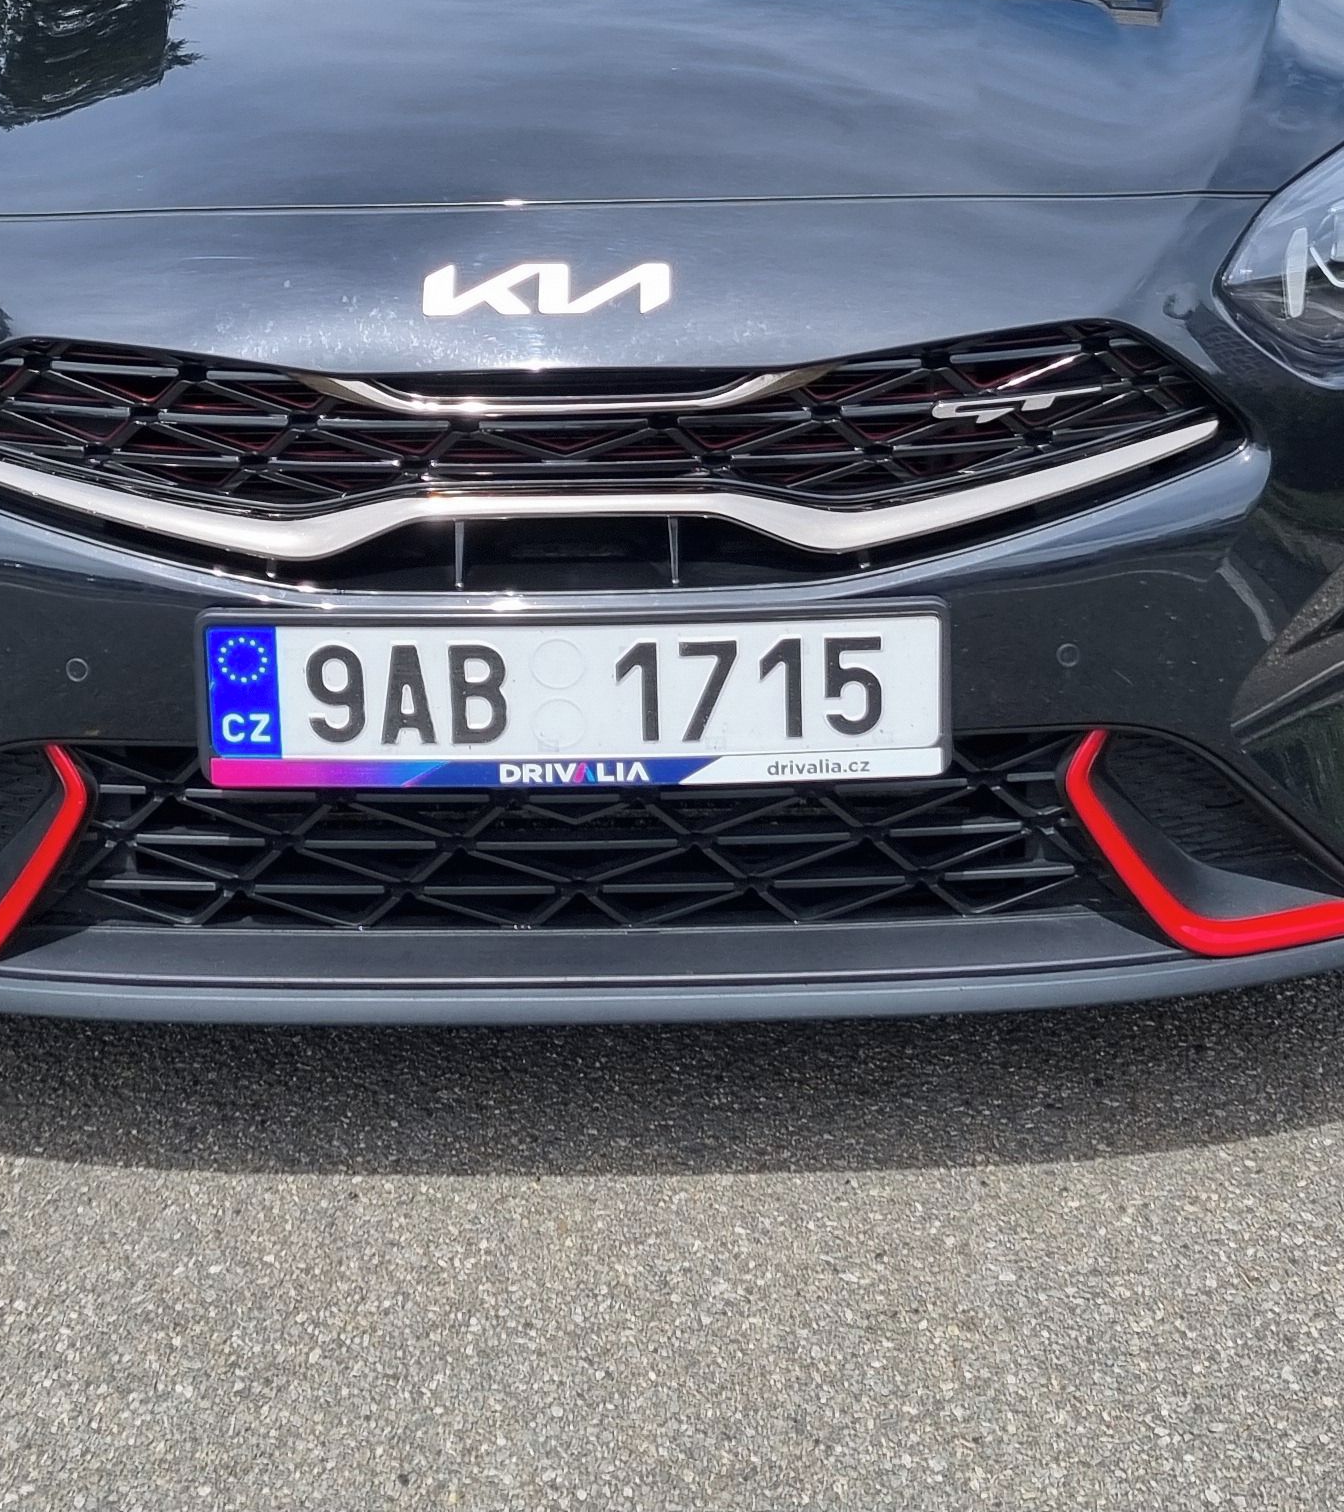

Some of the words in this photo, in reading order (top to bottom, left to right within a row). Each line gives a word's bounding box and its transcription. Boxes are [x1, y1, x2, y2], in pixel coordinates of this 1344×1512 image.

[422, 263, 671, 317] KIA
[304, 642, 508, 746] 9AB
[613, 635, 884, 743] 1715
[221, 713, 272, 743] CZ
[499, 761, 650, 784] DRIVALIA
[766, 757, 872, 778] drivalia.cz
